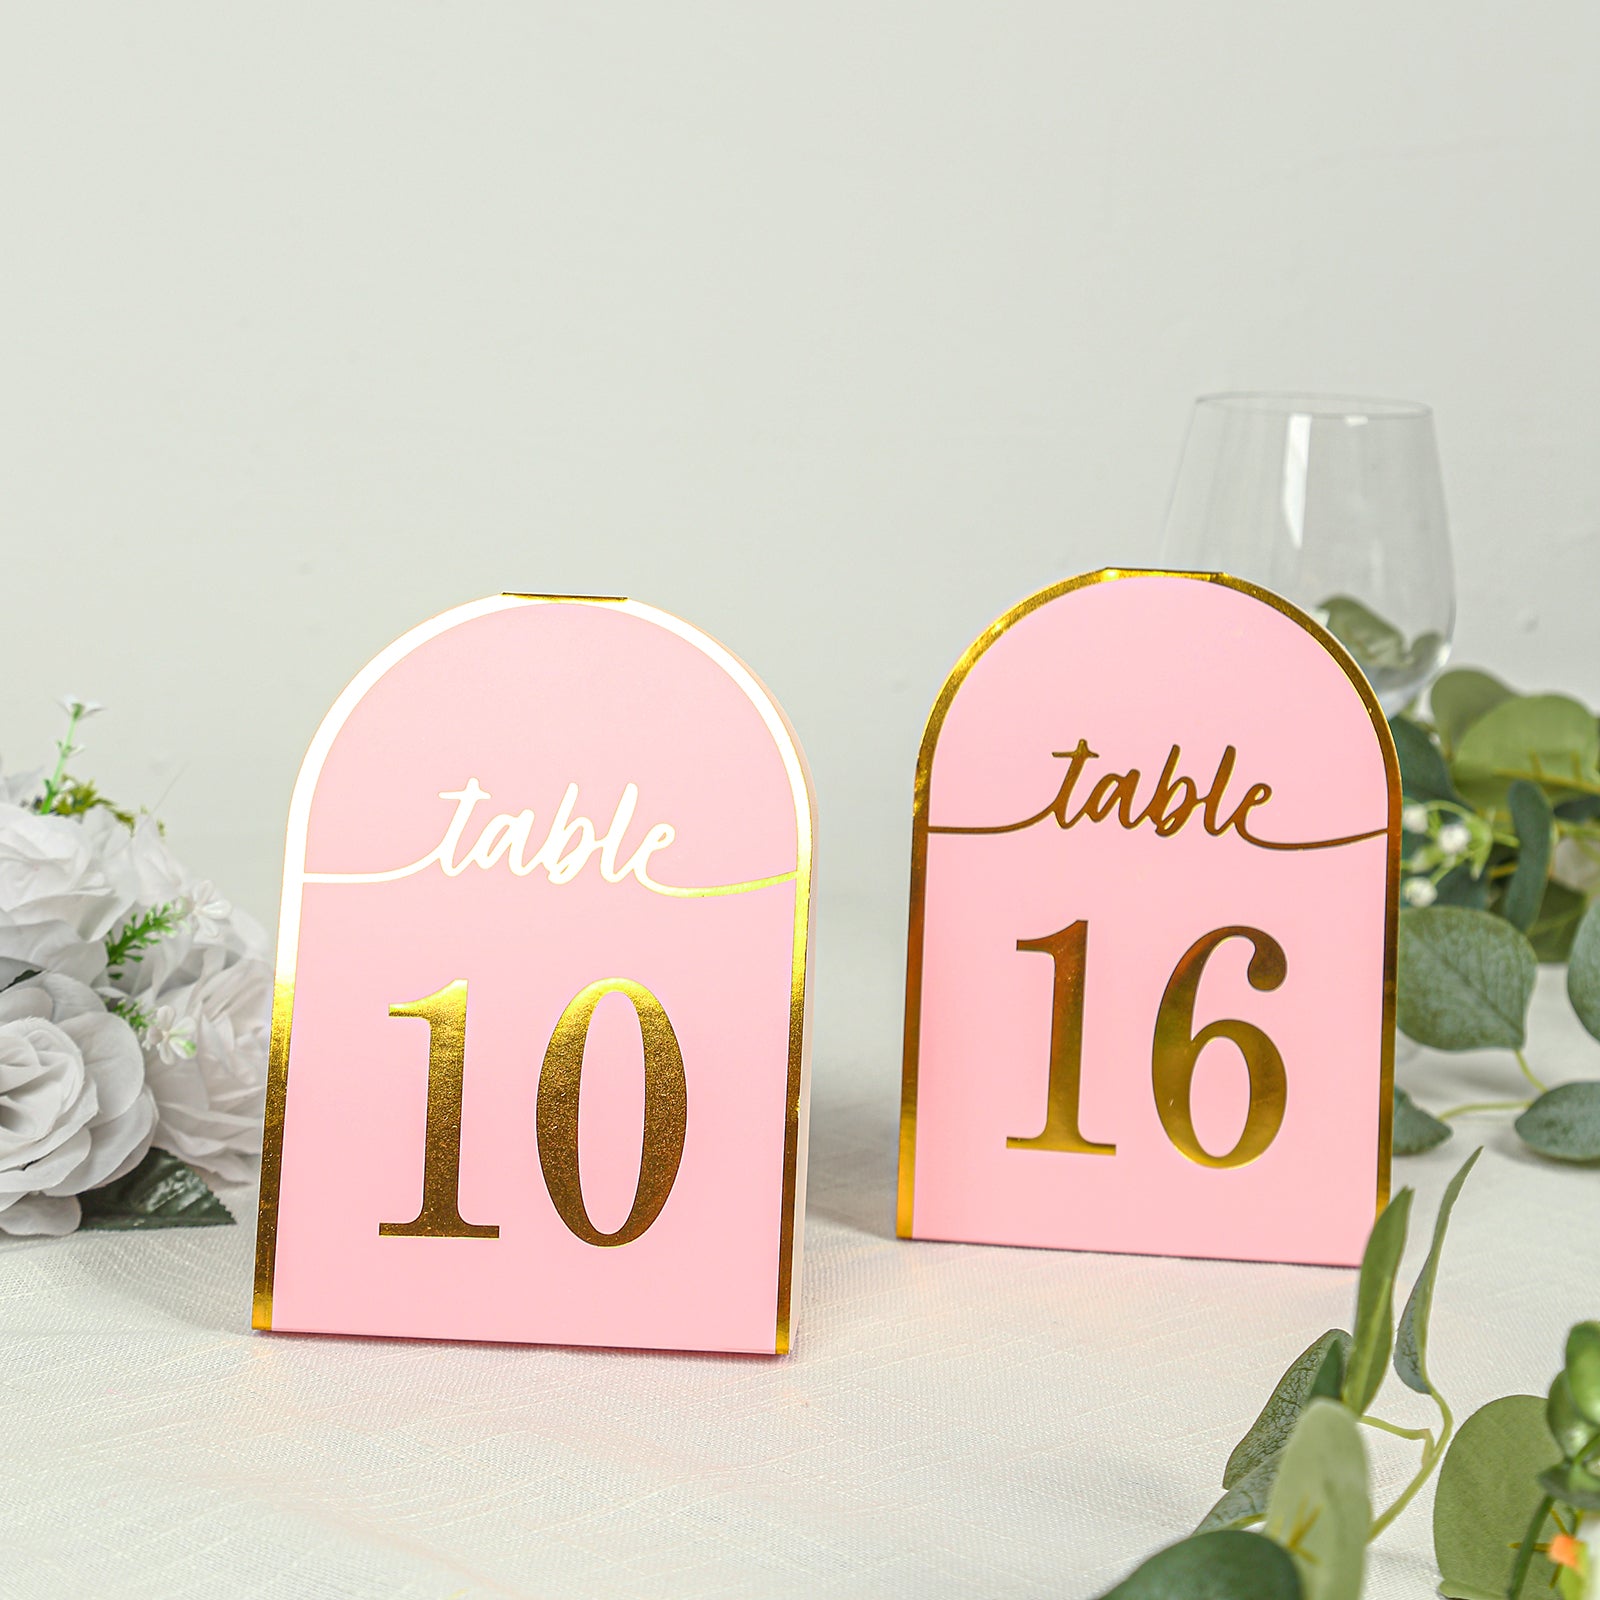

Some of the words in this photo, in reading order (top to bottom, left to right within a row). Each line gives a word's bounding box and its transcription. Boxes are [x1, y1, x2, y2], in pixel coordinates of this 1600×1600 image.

[420, 776, 698, 897] table
[1036, 737, 1290, 850] table
[377, 976, 689, 1248] 10
[1005, 918, 1289, 1170] 16
